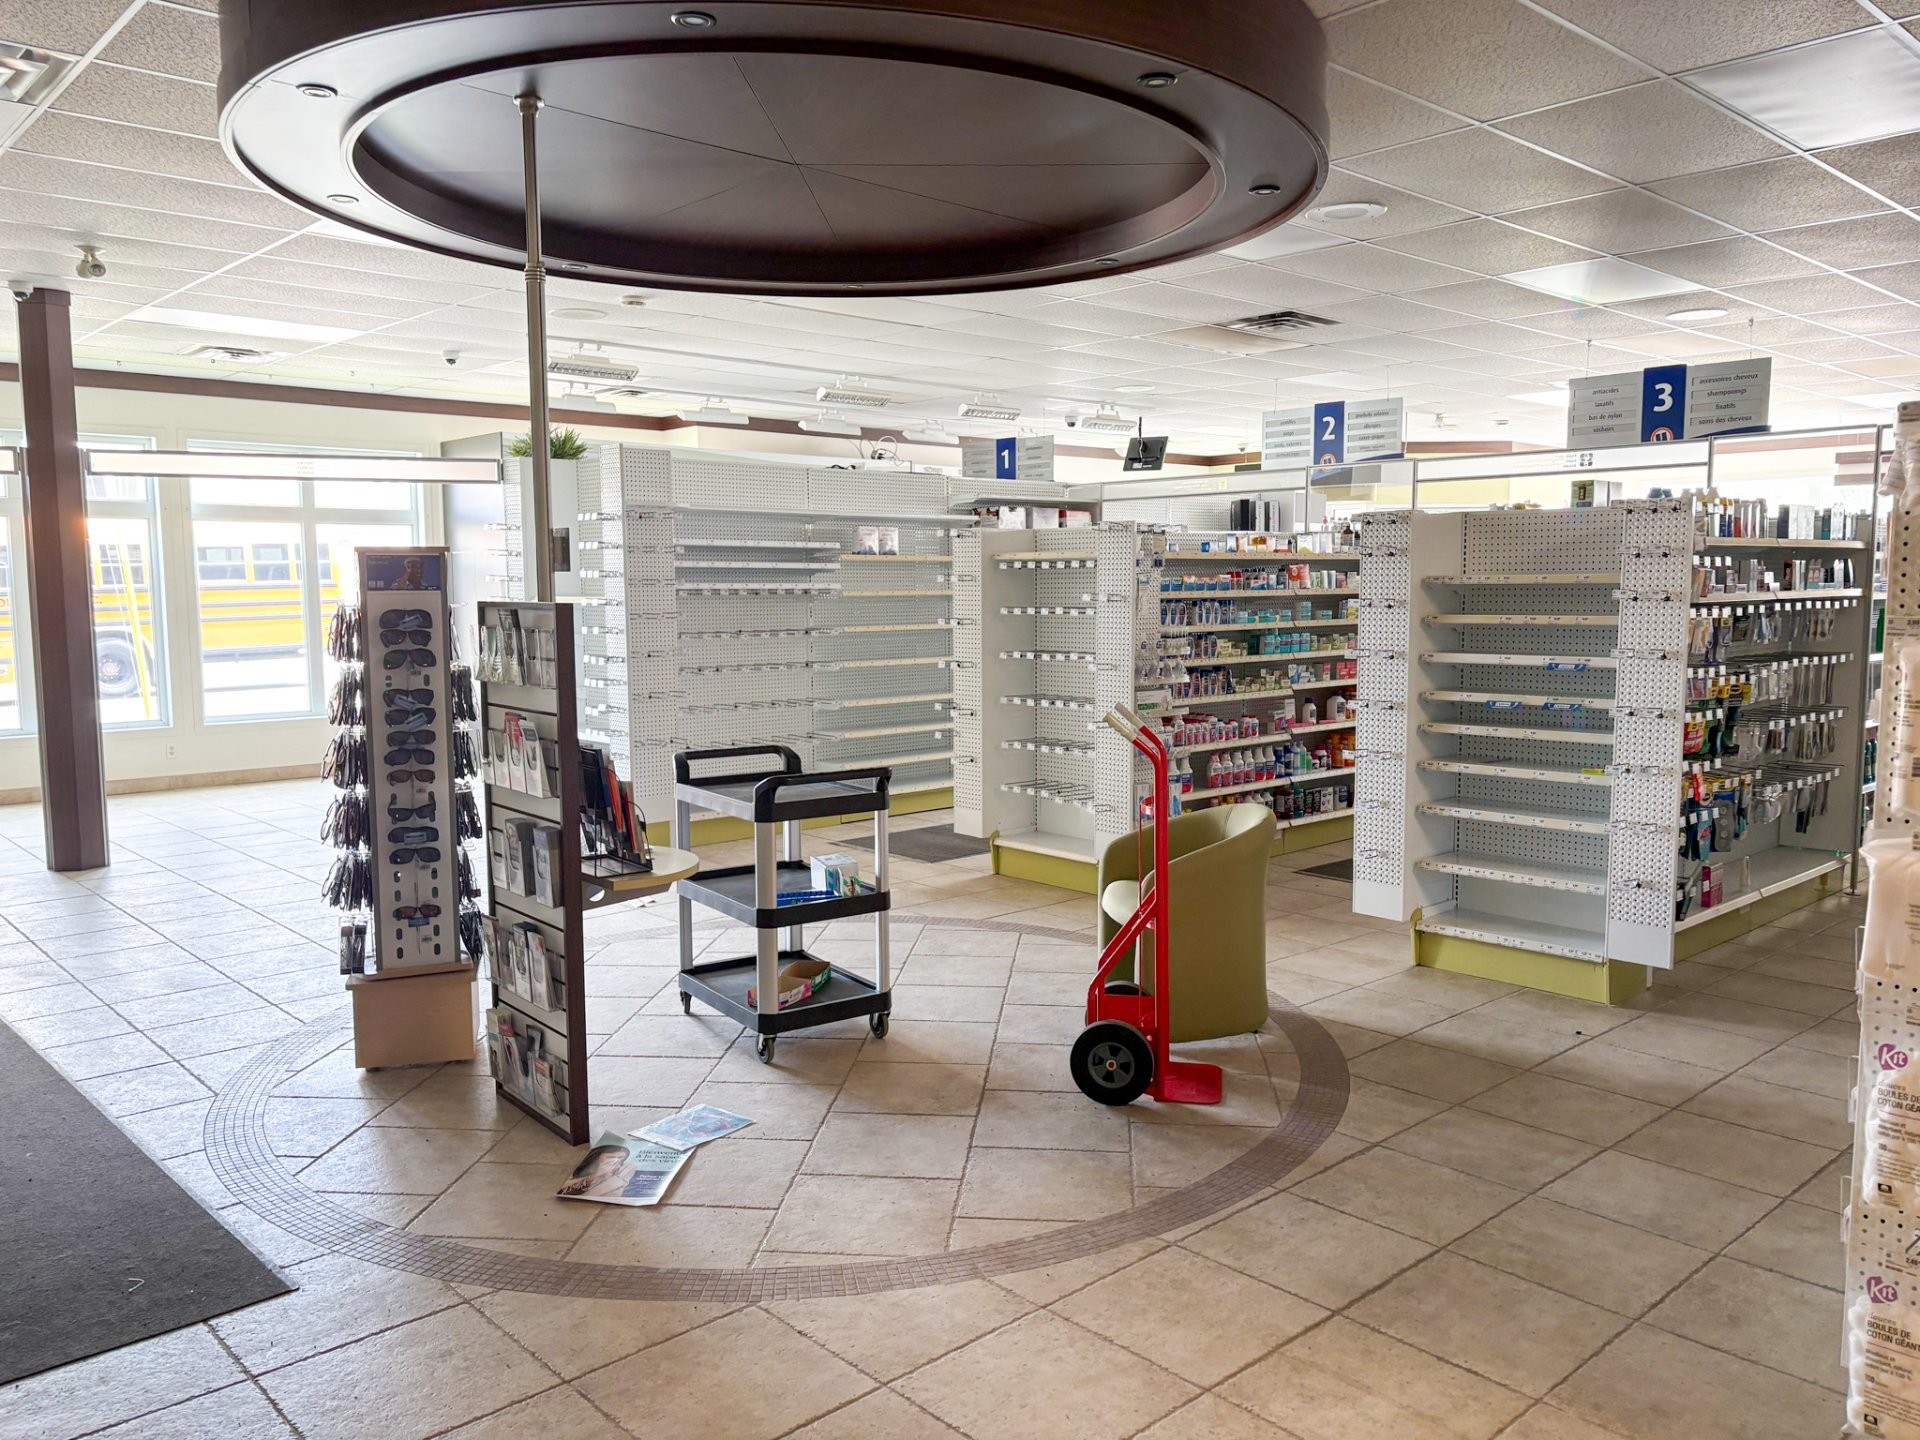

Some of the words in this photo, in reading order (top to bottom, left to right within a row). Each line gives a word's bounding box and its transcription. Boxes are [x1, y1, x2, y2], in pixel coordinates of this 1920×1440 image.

[1733, 373, 1758, 381] cheveux
[1653, 383, 1673, 412] 3
[1322, 416, 1336, 441] 2
[1727, 415, 1752, 423] cheveux
[1001, 449, 1009, 469] 1
[1880, 1045, 1907, 1070] Kit
[1877, 1088, 1909, 1102] BOULES
[1877, 1097, 1904, 1110] COTON
[1869, 1279, 1897, 1303] Kit
[1867, 1320, 1899, 1336] BOULES
[1900, 1329, 1911, 1341] DE
[1867, 1329, 1893, 1344] COTON
